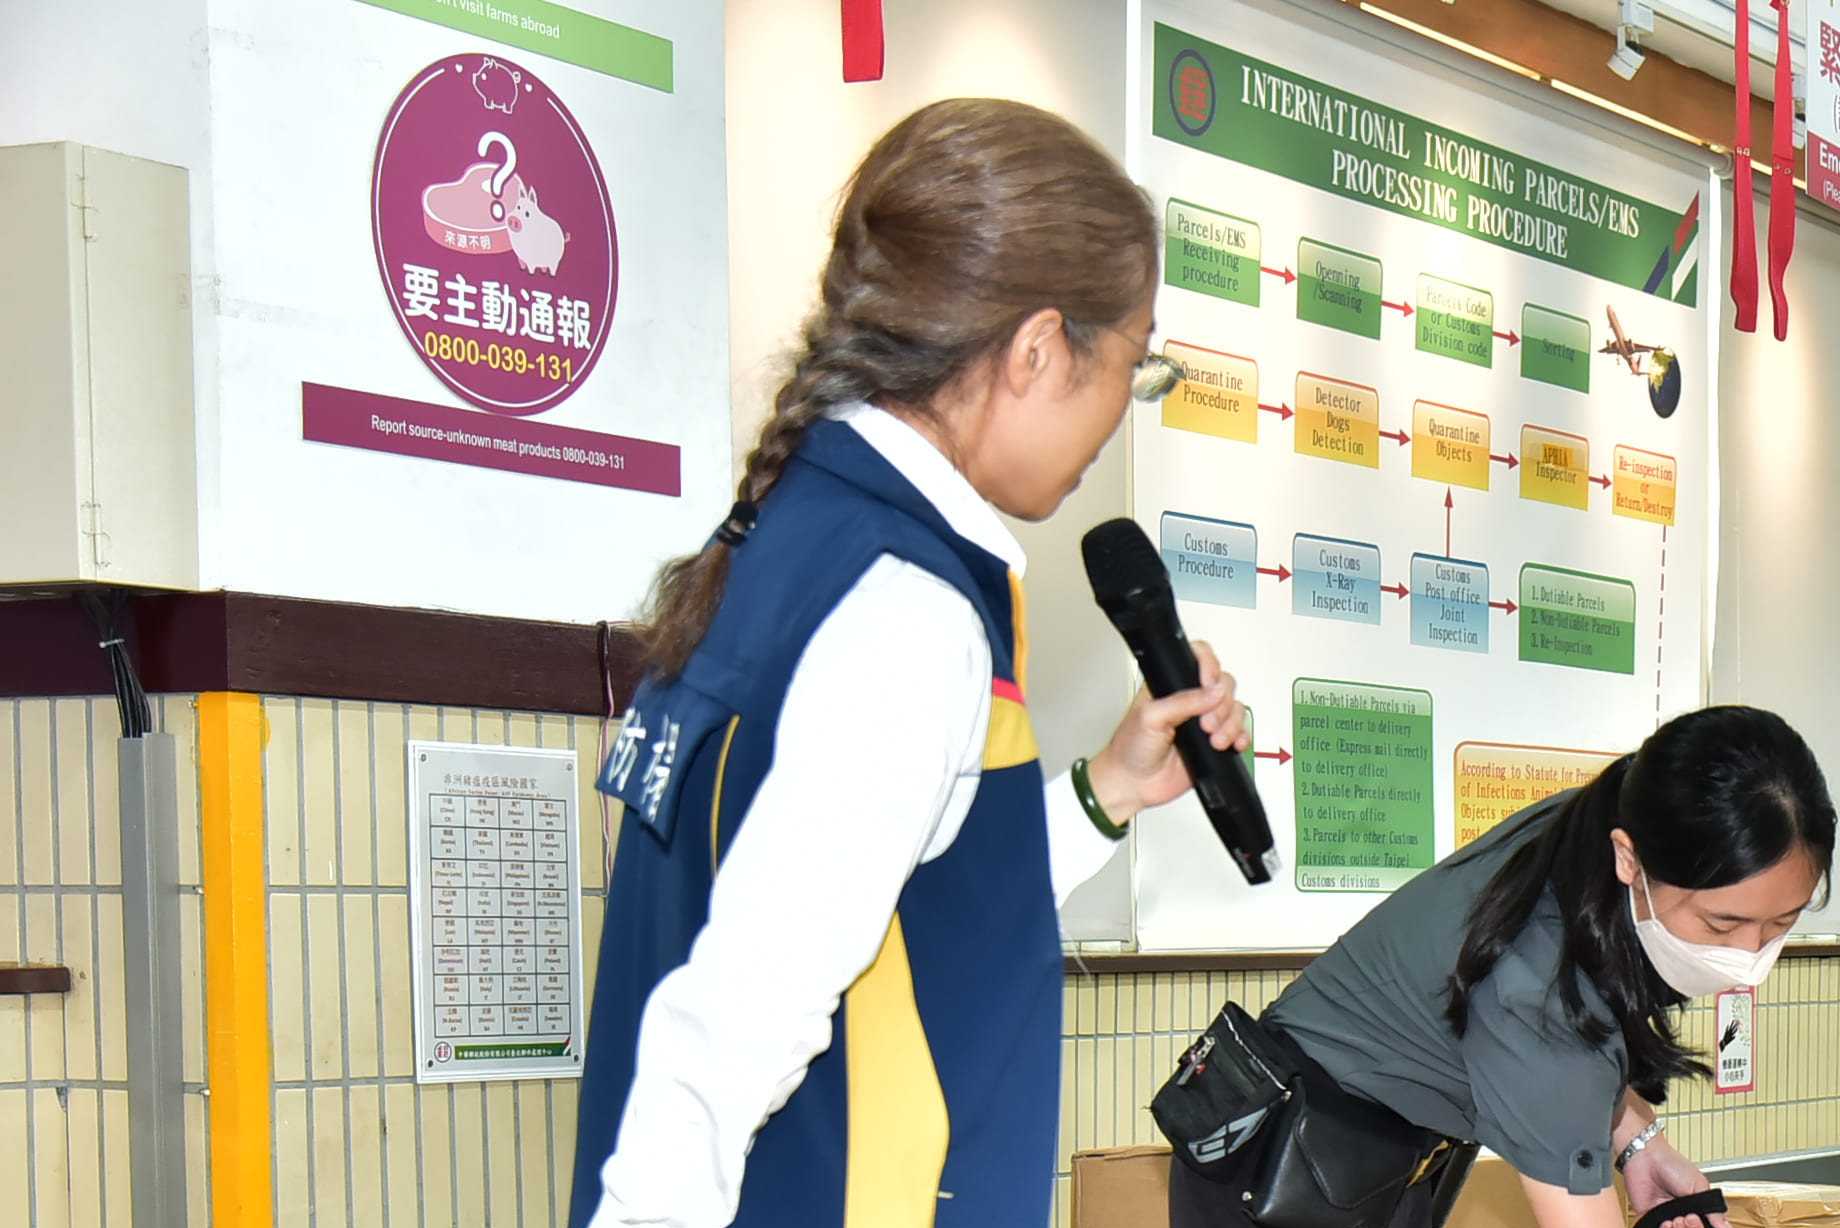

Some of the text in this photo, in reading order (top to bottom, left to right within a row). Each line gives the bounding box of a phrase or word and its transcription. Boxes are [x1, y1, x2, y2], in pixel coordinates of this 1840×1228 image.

[485, 6, 518, 26] farms
[521, 16, 560, 39] abroad
[1241, 65, 1410, 160] INTERNATIONAL
[1424, 131, 1515, 195] INCOMING
[1525, 167, 1640, 238] PARCELS/EMS
[1333, 150, 1568, 259] PROCESSING PROCEDURE
[444, 230, 491, 250] 來源不明
[1177, 213, 1246, 249] Parcels/EMS
[1183, 238, 1239, 272] Receiving
[1183, 264, 1239, 292] procedure
[1315, 260, 1360, 291] Openning
[403, 263, 591, 350] 要主動通報
[1312, 282, 1362, 313] /Scanning
[1427, 285, 1487, 318] Parcels Code
[1431, 312, 1481, 336] or Customs
[1423, 326, 1488, 359] Division code
[1543, 338, 1576, 363] Sorting
[424, 331, 573, 383] 0800-039-131
[1182, 360, 1244, 391] Quarantine
[1184, 384, 1240, 413] Procedure
[1316, 387, 1361, 413] Detector
[1326, 411, 1350, 433] Dogs
[1429, 417, 1480, 445] Quarantine
[371, 415, 625, 470] Report source-unknown meat products 0800-039-131
[1312, 429, 1364, 456] Detection
[1436, 441, 1472, 463] Objects
[1536, 460, 1576, 485] Inspector
[1618, 456, 1673, 482] Re-inspection
[1640, 484, 1649, 495] or
[1615, 492, 1673, 521] Return/Destroy
[1184, 532, 1228, 557] Customs
[1178, 554, 1234, 579] Procedure
[1320, 549, 1361, 571] Customs
[1325, 572, 1356, 593] X-Ray
[1435, 564, 1471, 585] Customs
[1312, 590, 1369, 615] Inspection
[1425, 582, 1480, 605] Post office
[1577, 592, 1605, 612] Parcels
[1440, 604, 1466, 623] Joint
[1429, 623, 1478, 646] Inspection
[1370, 696, 1399, 713] Parcels
[1402, 700, 1416, 714] via
[1300, 715, 1329, 730] parcel
[1335, 719, 1364, 731] center
[1379, 721, 1412, 738] delivery
[1300, 736, 1427, 760] office (Express mail directly
[1302, 761, 1312, 773] to
[1316, 761, 1355, 778] delivery
[1461, 760, 1506, 781] According
[1511, 765, 1521, 779] to
[1525, 765, 1558, 782] Statute
[1562, 767, 1573, 782] for
[1354, 784, 1385, 800] Parcels
[1389, 787, 1421, 804] directly
[1461, 783, 1471, 797] of
[1477, 782, 1526, 800] Infections
[1304, 806, 1386, 823] to delivery office
[1461, 803, 1496, 821] Objects
[1351, 831, 1359, 843] to
[1363, 831, 1386, 844] other
[1389, 831, 1418, 845] Customs
[1303, 850, 1409, 869] divisions outside Taipei
[1302, 873, 1380, 888] Customs divisions
